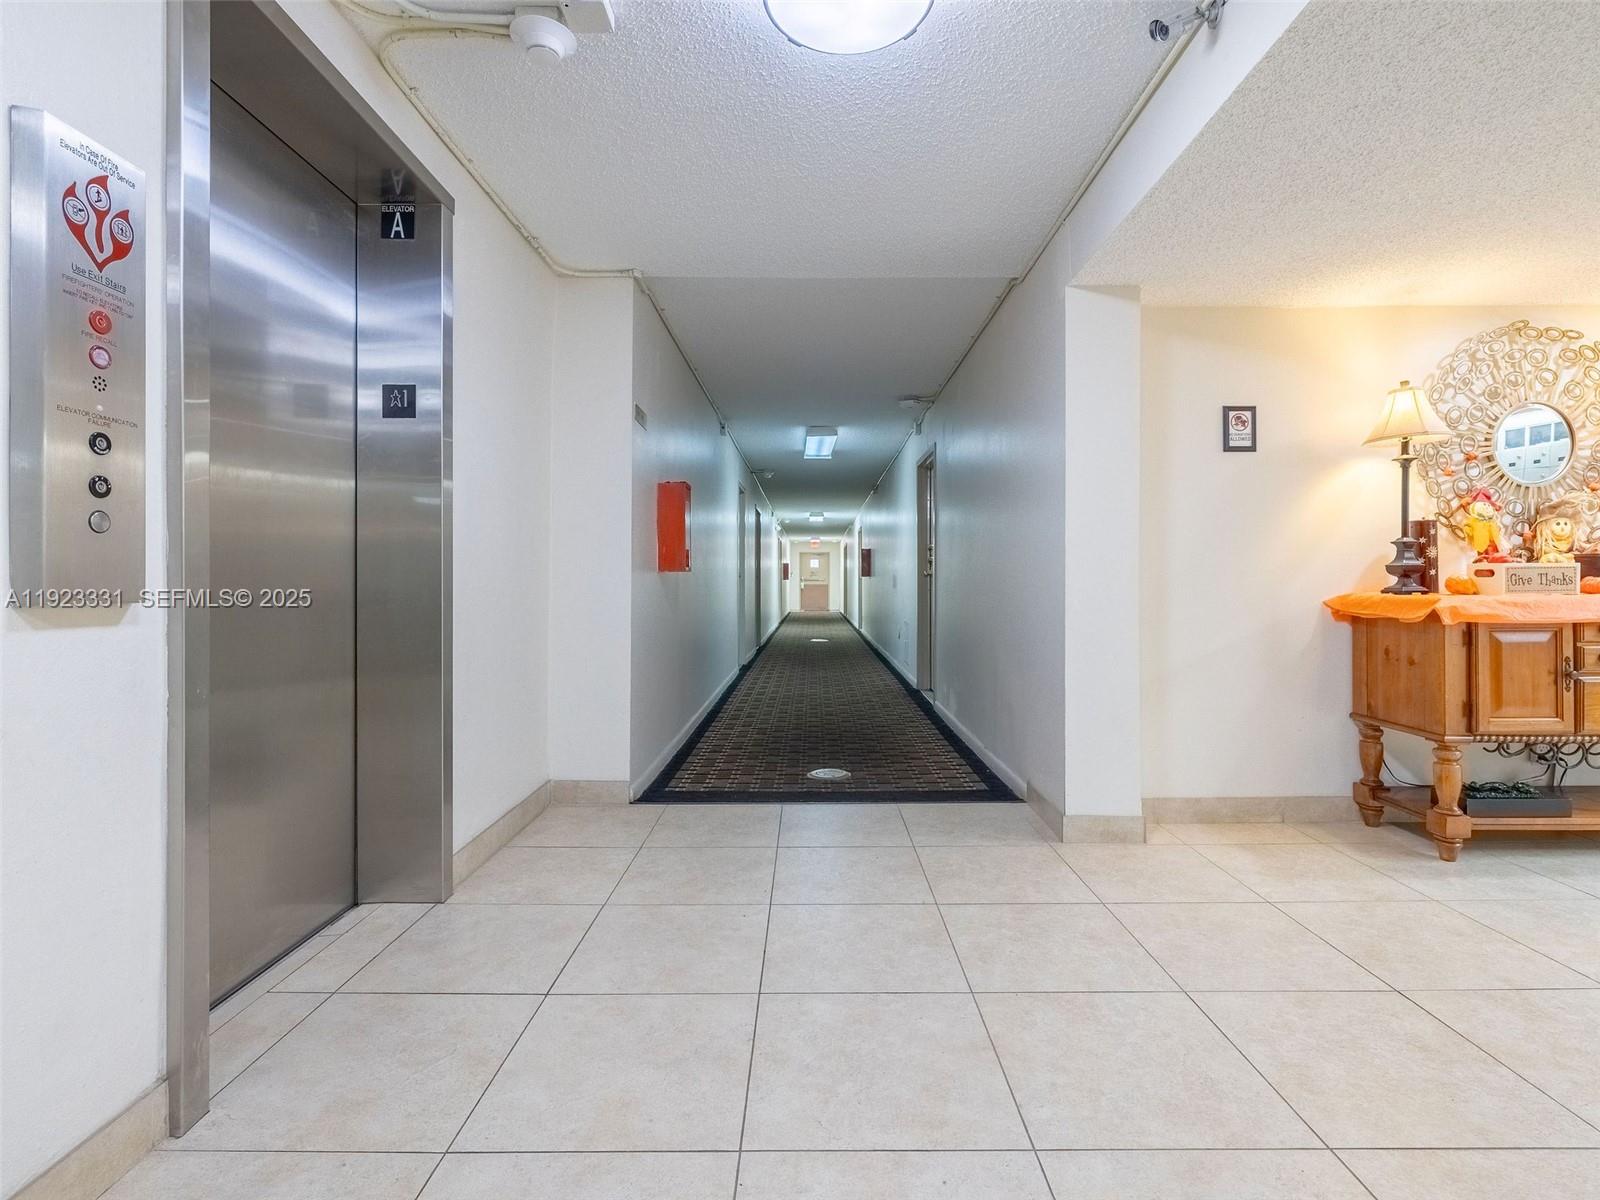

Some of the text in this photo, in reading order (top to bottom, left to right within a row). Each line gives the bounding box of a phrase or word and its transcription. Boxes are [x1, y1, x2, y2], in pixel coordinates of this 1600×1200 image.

[60, 138, 136, 189] Elevators Are Out Of Service
[86, 146, 99, 160] Case
[100, 154, 107, 164] Of
[108, 158, 118, 171] Fire
[381, 205, 415, 213] ELEVATOR
[390, 212, 405, 239] A
[71, 262, 127, 293] Use Exit Stairs
[56, 404, 138, 429] ELEVATOR COMMUNICATION
[87, 418, 112, 429] FAILURE
[1509, 572, 1574, 587] Give Thanks
